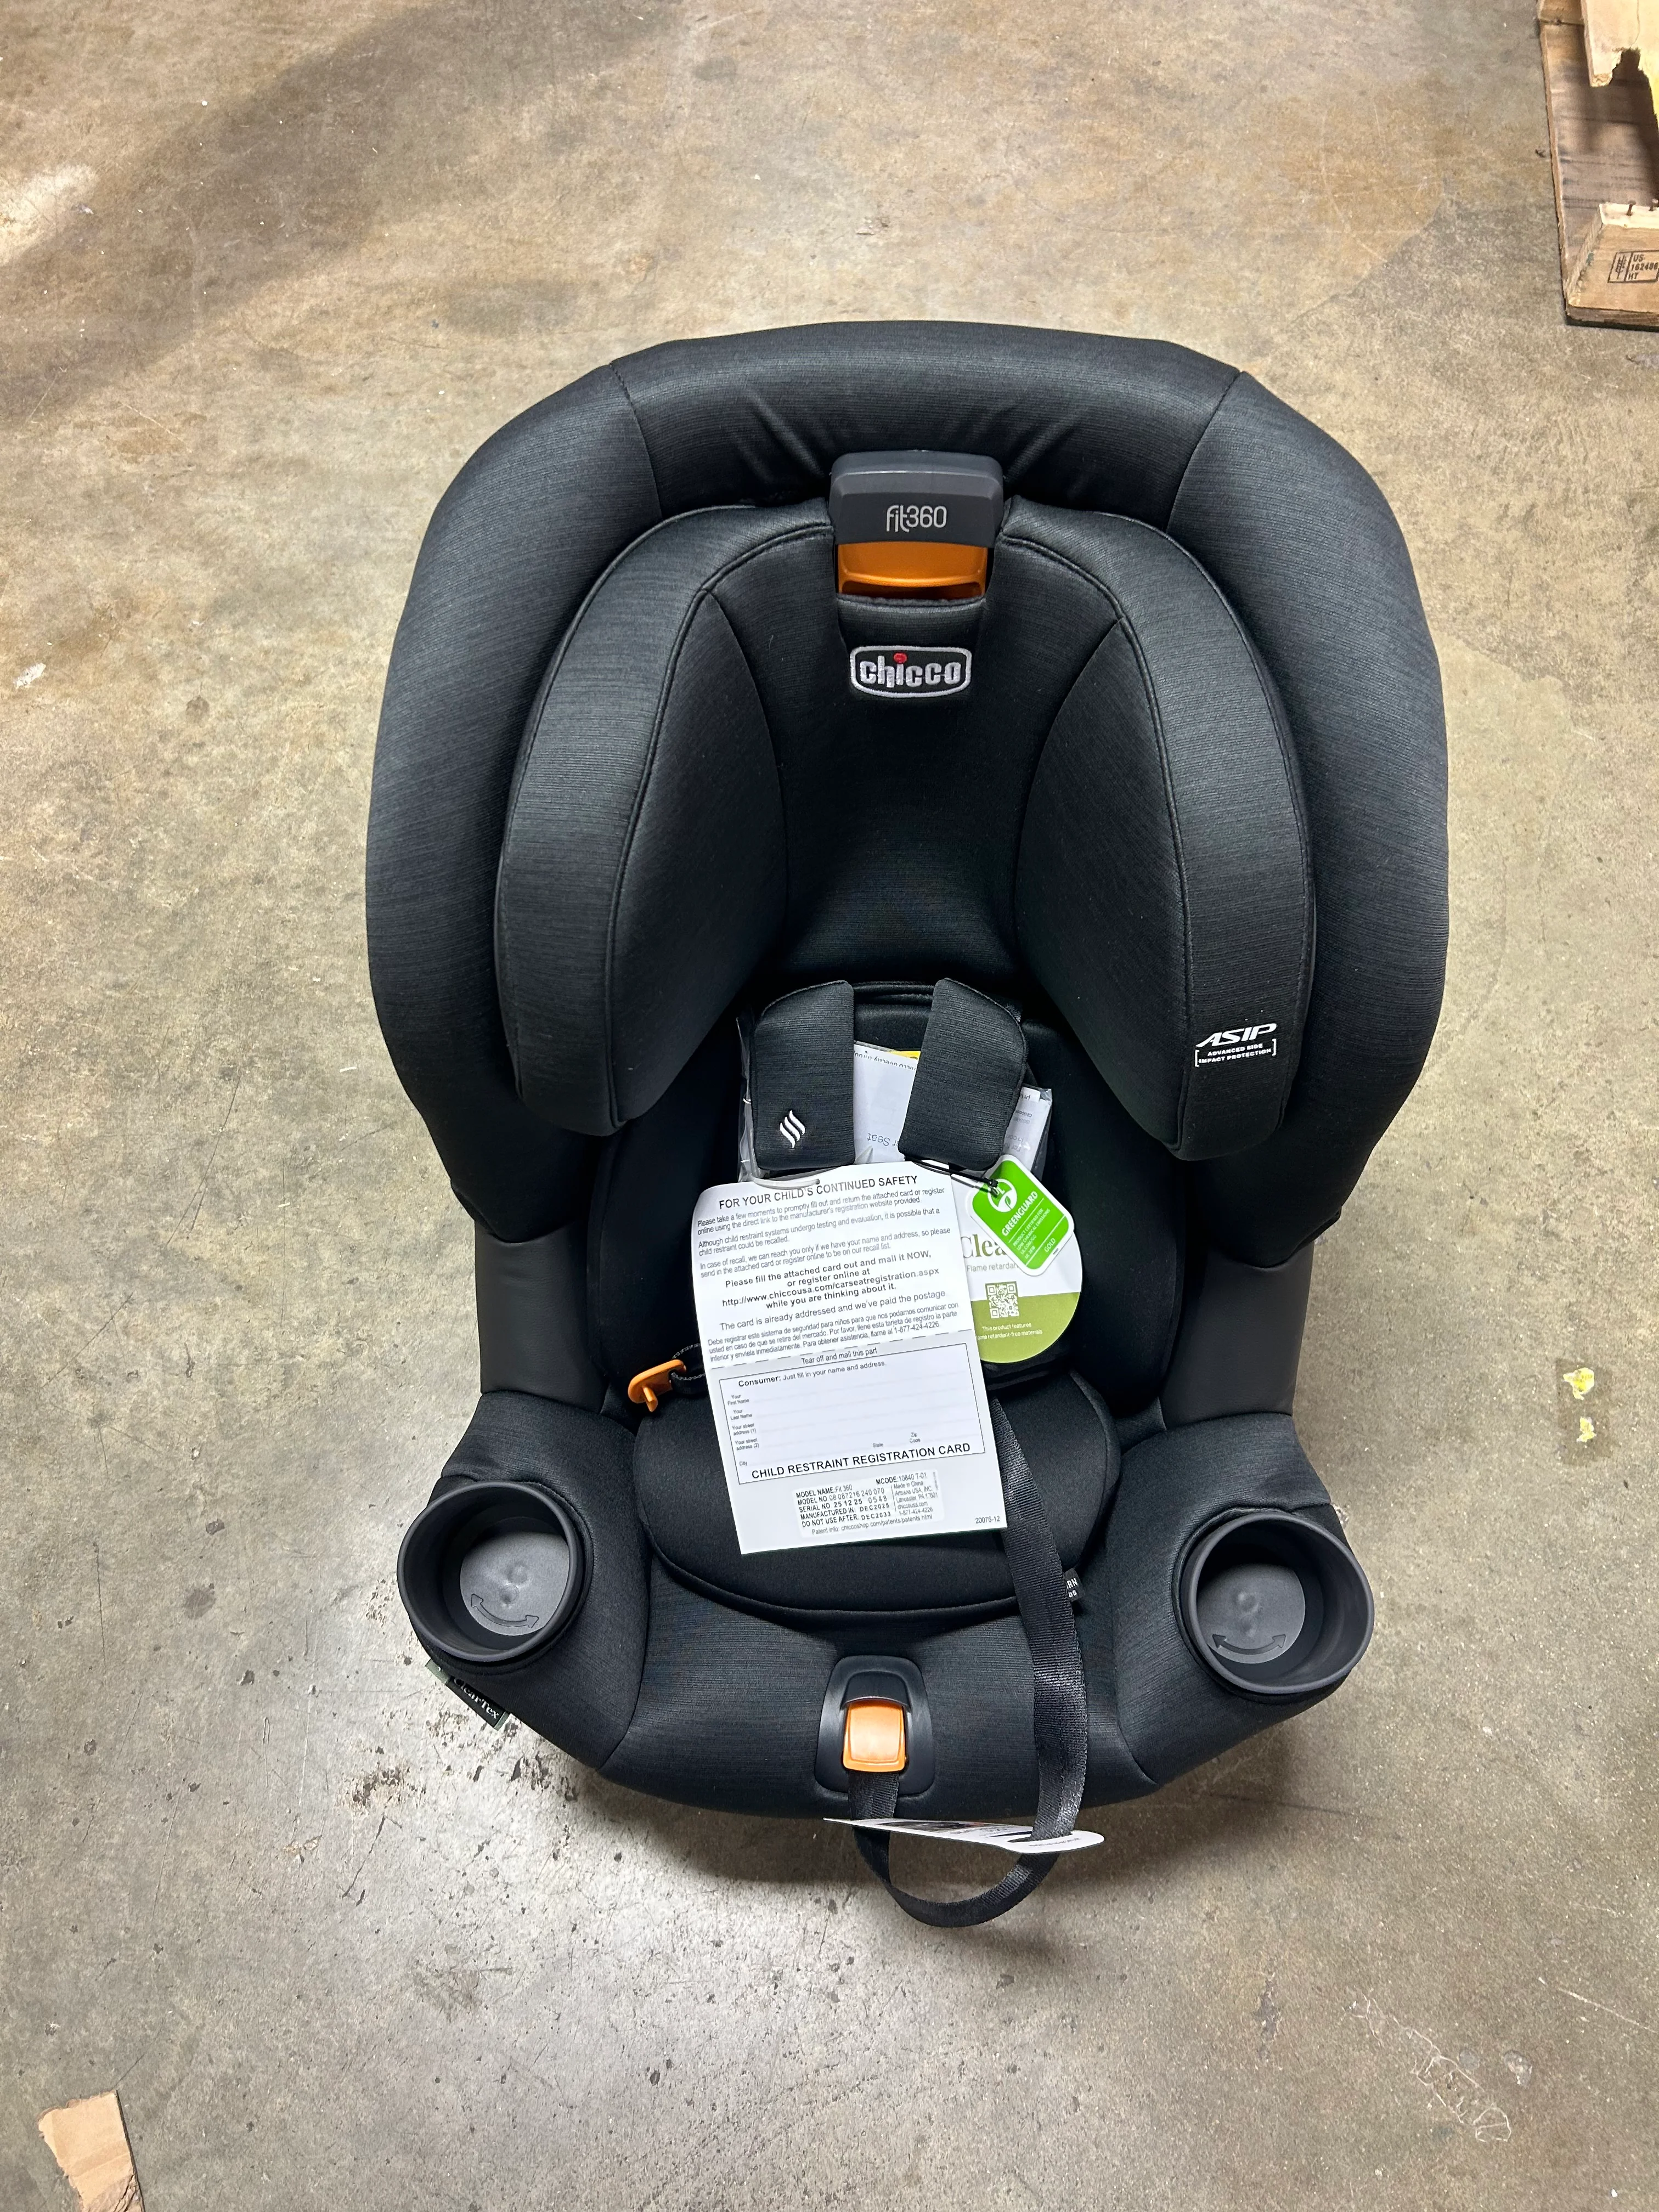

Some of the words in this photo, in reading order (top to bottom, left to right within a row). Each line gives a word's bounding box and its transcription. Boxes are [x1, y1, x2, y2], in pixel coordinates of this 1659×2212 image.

[886, 505, 947, 532] fit360
[860, 652, 962, 687] chicco
[1195, 1023, 1277, 1047] ASIP
[1207, 1047, 1245, 1056] ADVANCED
[1227, 1048, 1271, 1060] PROTECTION
[867, 1133, 890, 1147] Seat
[719, 1199, 740, 1209] FOR
[742, 1194, 771, 1205] YOUR
[775, 1187, 813, 1200] CHILD'S
[817, 1179, 875, 1194] CONTINUED
[879, 1176, 917, 1186] SAFETY
[748, 1209, 775, 1217] moments
[785, 1204, 809, 1213] promptly
[873, 1191, 898, 1199] attached
[1002, 1191, 1038, 1236] GREENGUARD
[961, 1234, 1006, 1259] Clea
[1044, 1238, 1056, 1252] GOLD
[726, 1278, 753, 1288] Please
[784, 1266, 820, 1278] attached
[823, 1263, 841, 1272] card
[860, 1258, 876, 1266] and
[878, 1255, 896, 1264] mail
[907, 1250, 931, 1260] NOW,
[799, 1275, 831, 1286] register
[833, 1271, 859, 1279] online
[766, 1300, 788, 1308] while
[791, 1299, 806, 1307] you
[824, 1289, 859, 1300] thinking
[862, 1284, 886, 1294] about
[737, 1319, 754, 1328] card
[765, 1313, 793, 1324] already
[795, 1306, 836, 1319] addressed
[838, 1304, 852, 1312] and
[855, 1300, 877, 1309] we've
[880, 1297, 896, 1307] paid
[914, 1290, 945, 1301] postage
[802, 1356, 814, 1365] Tear
[839, 1351, 851, 1359] mail
[865, 1347, 877, 1356] part
[738, 1375, 781, 1387] Consumer:
[783, 1373, 795, 1381] Just
[812, 1369, 826, 1378] your
[752, 1466, 785, 1479] CHILD
[788, 1458, 849, 1474] RESTRAINT
[853, 1447, 935, 1465] REGISTRATION
[939, 1443, 970, 1454] CARD
[796, 1490, 816, 1498] MODEL
[838, 1491, 860, 1499] 087216
[800, 1508, 847, 1520] MANUFACTURED
[860, 1503, 889, 1512] DEC2025
[861, 1511, 891, 1520] DEC2033
